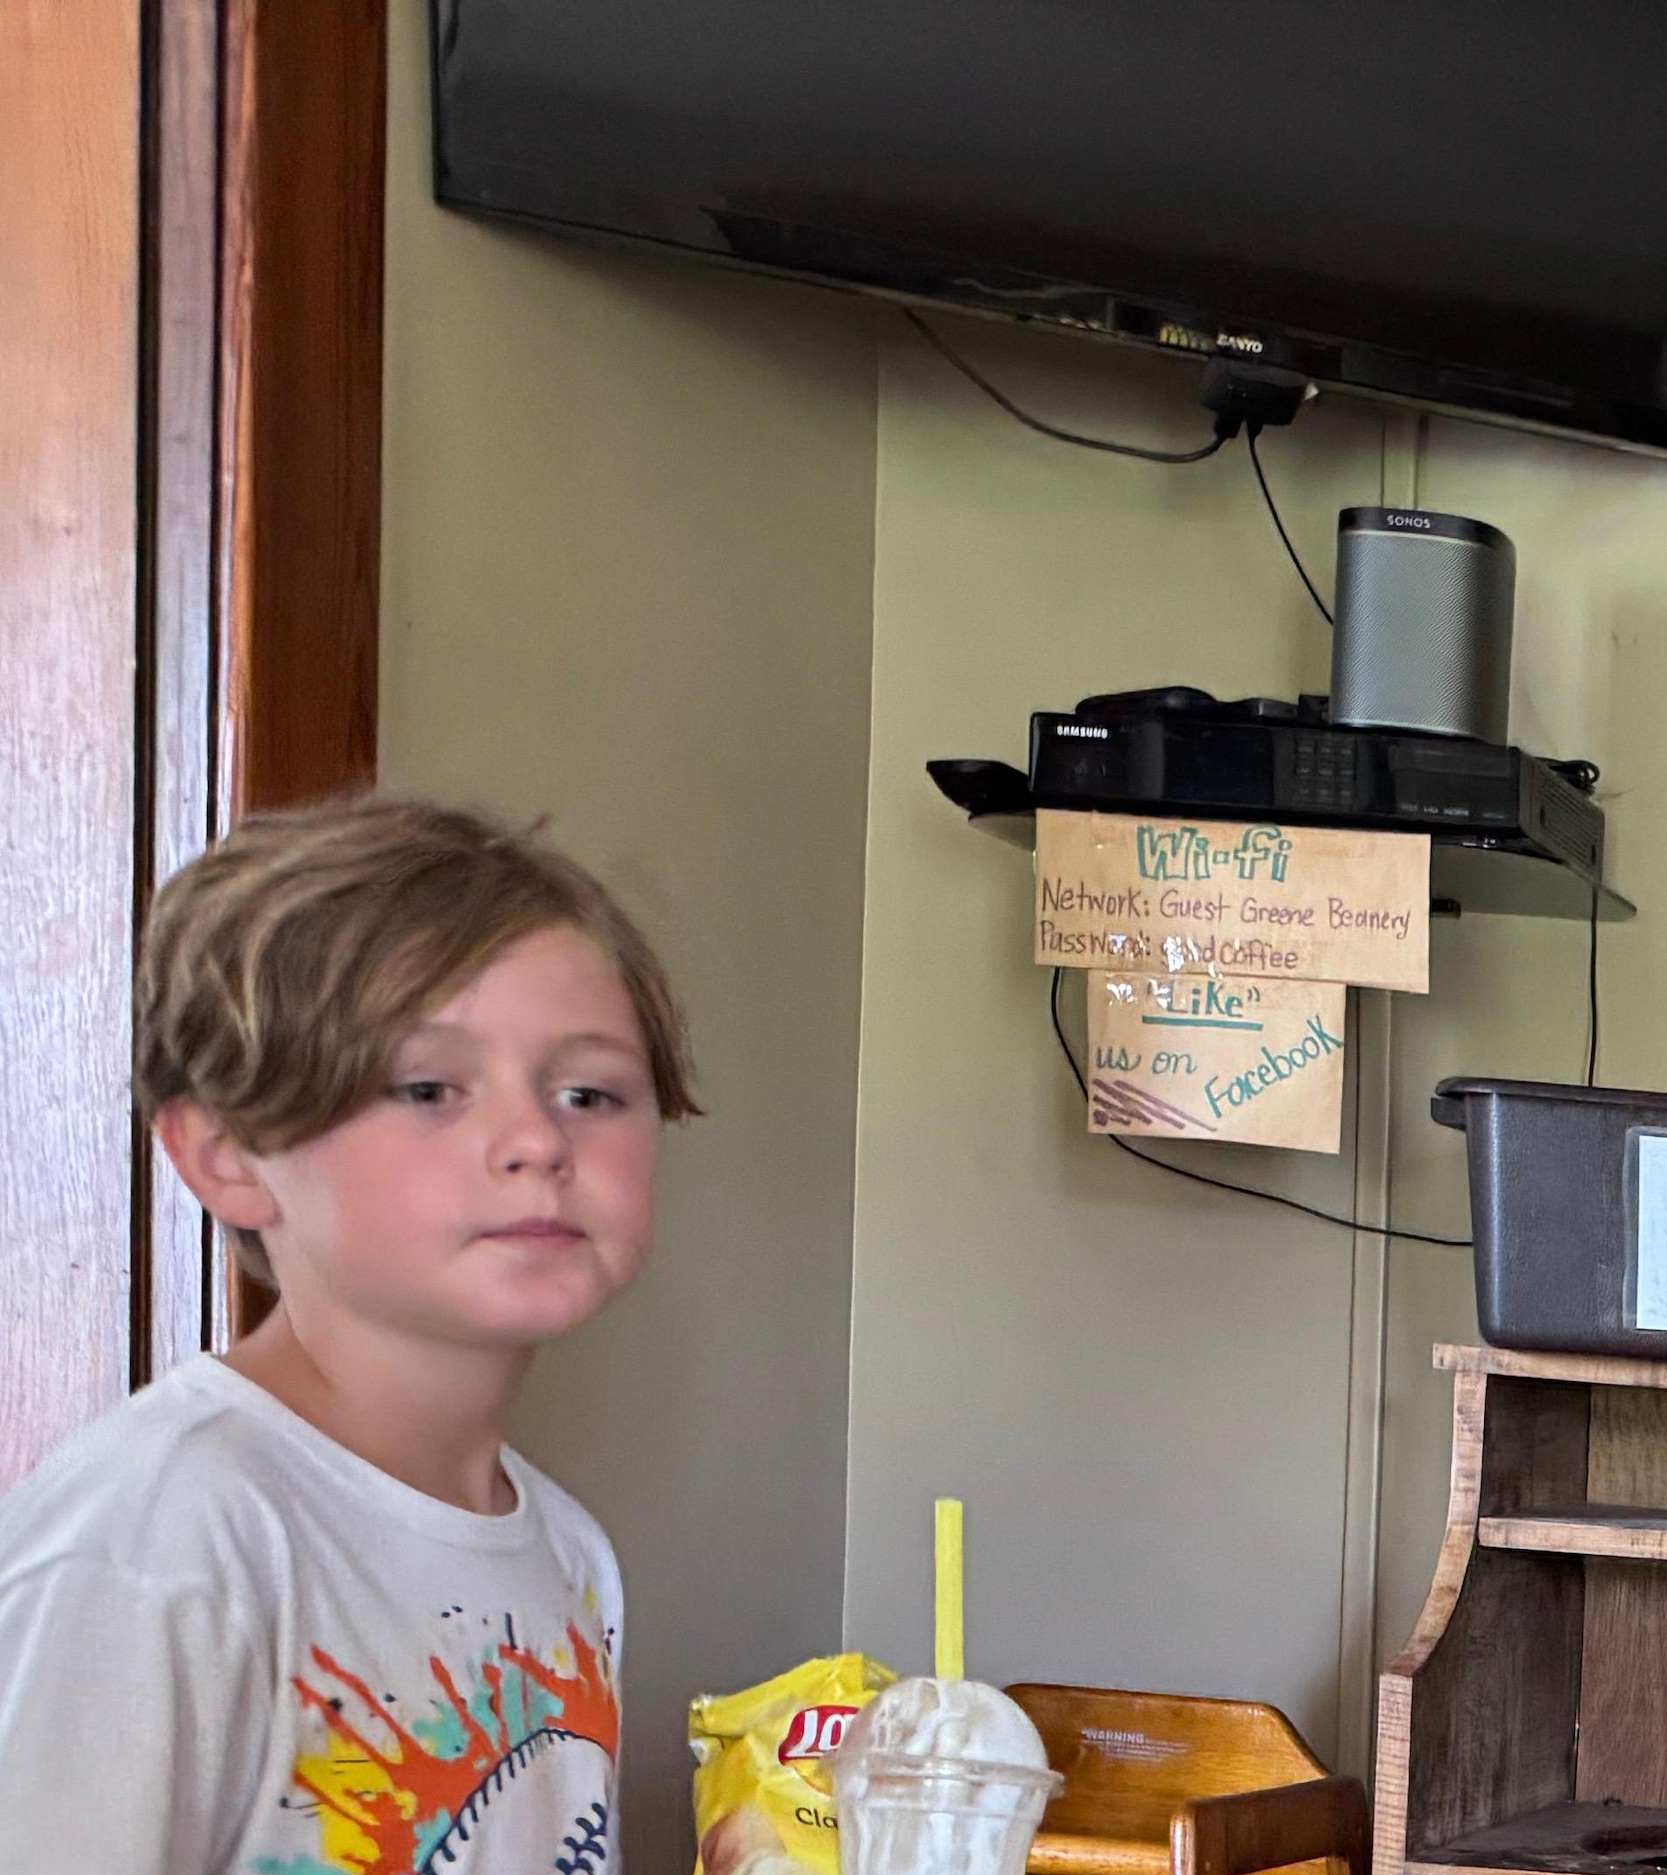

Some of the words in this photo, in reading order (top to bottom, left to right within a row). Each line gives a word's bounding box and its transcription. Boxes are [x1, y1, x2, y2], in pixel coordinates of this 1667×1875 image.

[1386, 514, 1431, 529] SONOS
[1041, 877, 1150, 919] Network:
[1159, 888, 1231, 923] Guest
[1240, 896, 1314, 926] Greene
[1327, 896, 1410, 940] Beanery
[1151, 1051, 1197, 1075] on
[1203, 1014, 1345, 1118] Facebook
[785, 1709, 856, 1757] La
[795, 1807, 839, 1831] Cla
